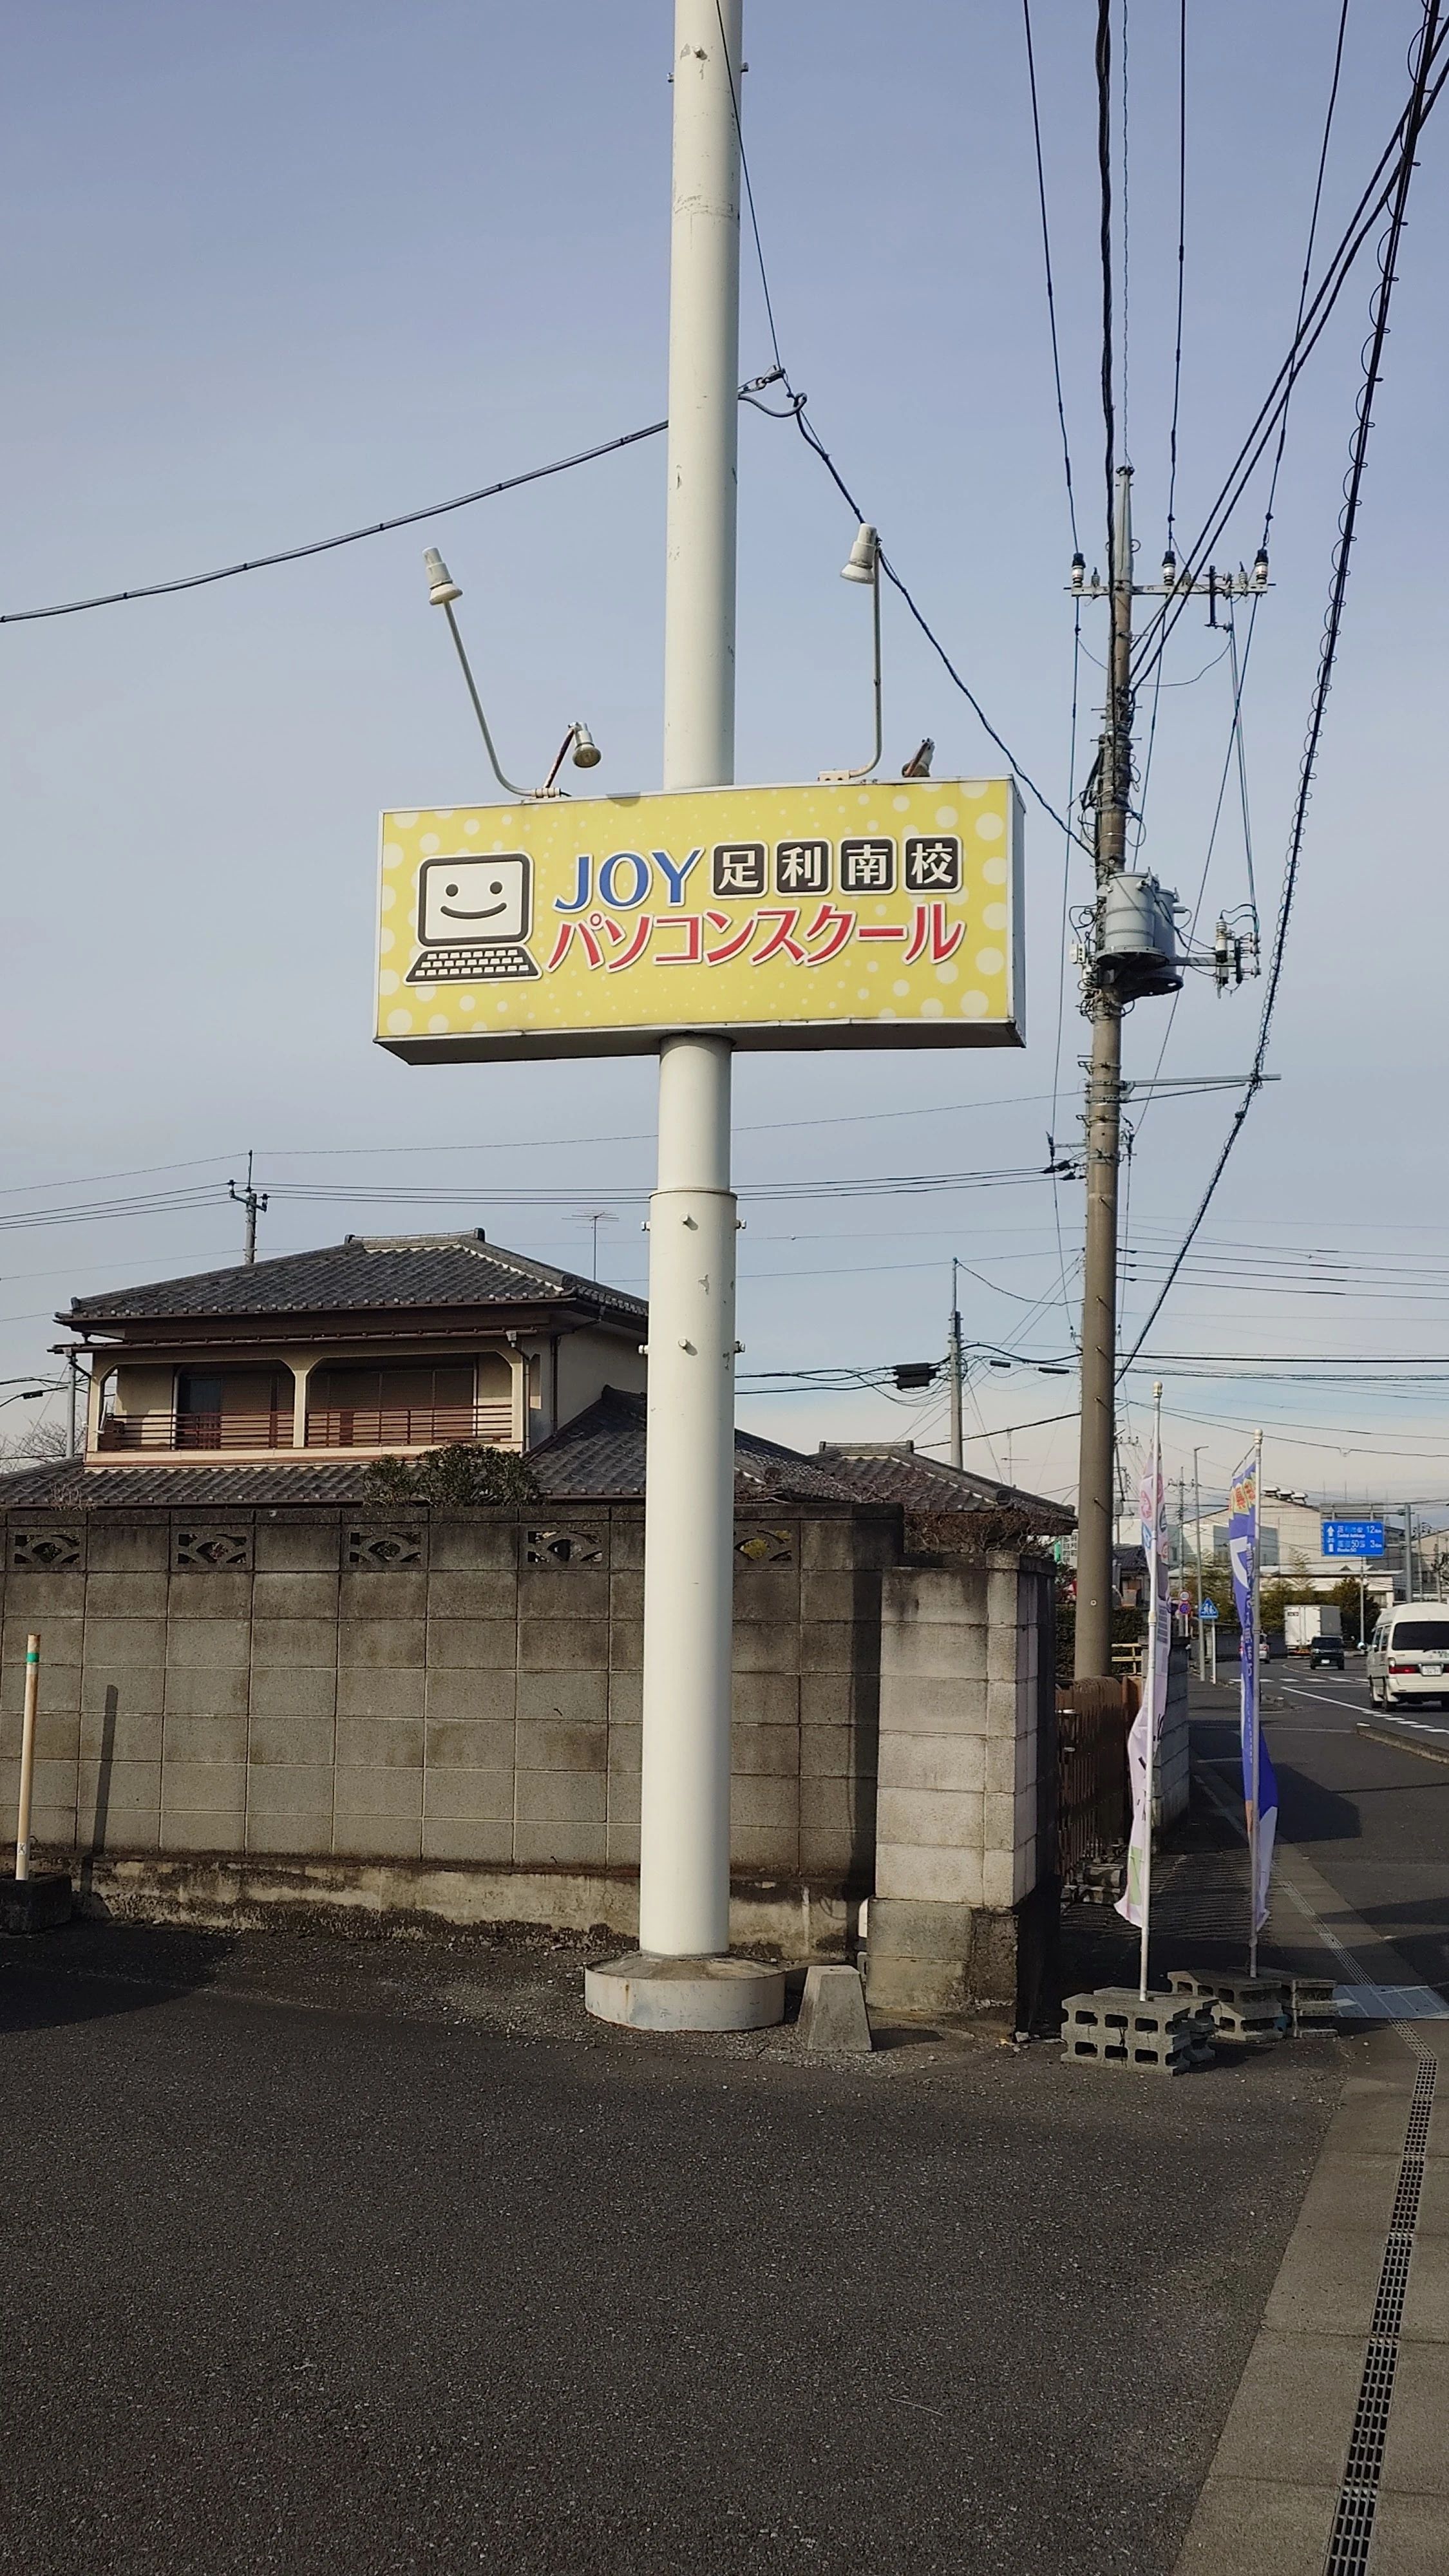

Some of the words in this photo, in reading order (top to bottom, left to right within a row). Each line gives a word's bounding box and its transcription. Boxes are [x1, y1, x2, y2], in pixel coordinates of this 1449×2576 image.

[554, 848, 703, 911] JOY
[715, 840, 956, 892] 足利南校
[547, 903, 963, 969] パソコンスクール
